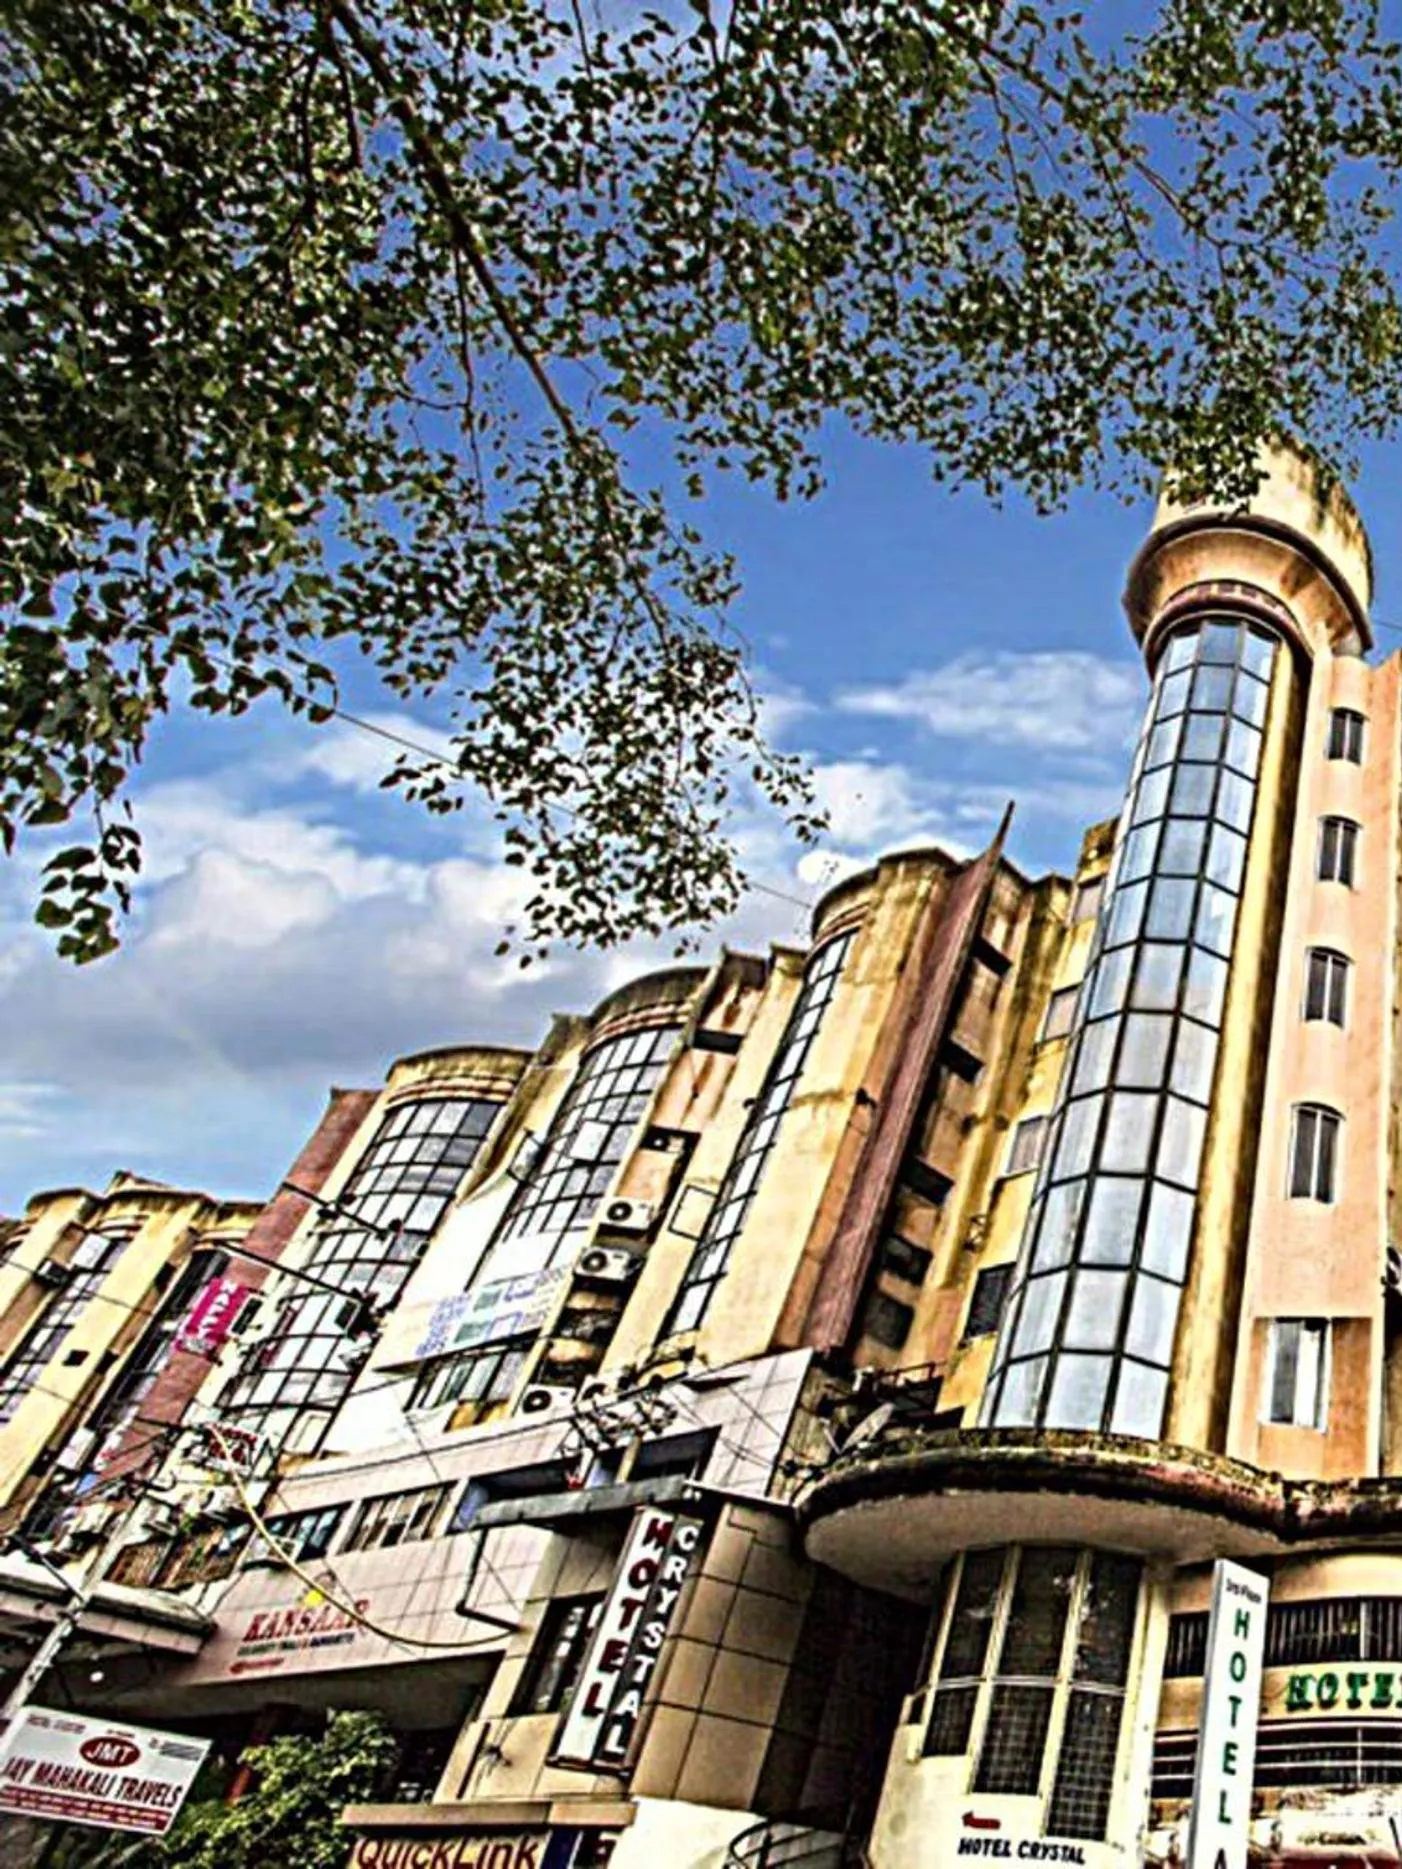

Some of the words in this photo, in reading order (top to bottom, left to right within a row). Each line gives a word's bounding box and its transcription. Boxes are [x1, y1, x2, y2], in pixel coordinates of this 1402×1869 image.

[581, 1516, 674, 1718] HOTEL
[605, 1526, 699, 1754] CRYSTAL
[86, 1742, 135, 1764] JMT
[1218, 1608, 1250, 1824] HOTEL
[30, 1761, 119, 1798] MAHAKALI
[114, 1776, 184, 1808] TRAVELS
[958, 1837, 1011, 1857] HOTEL
[1018, 1840, 1086, 1865] CRYSTAL
